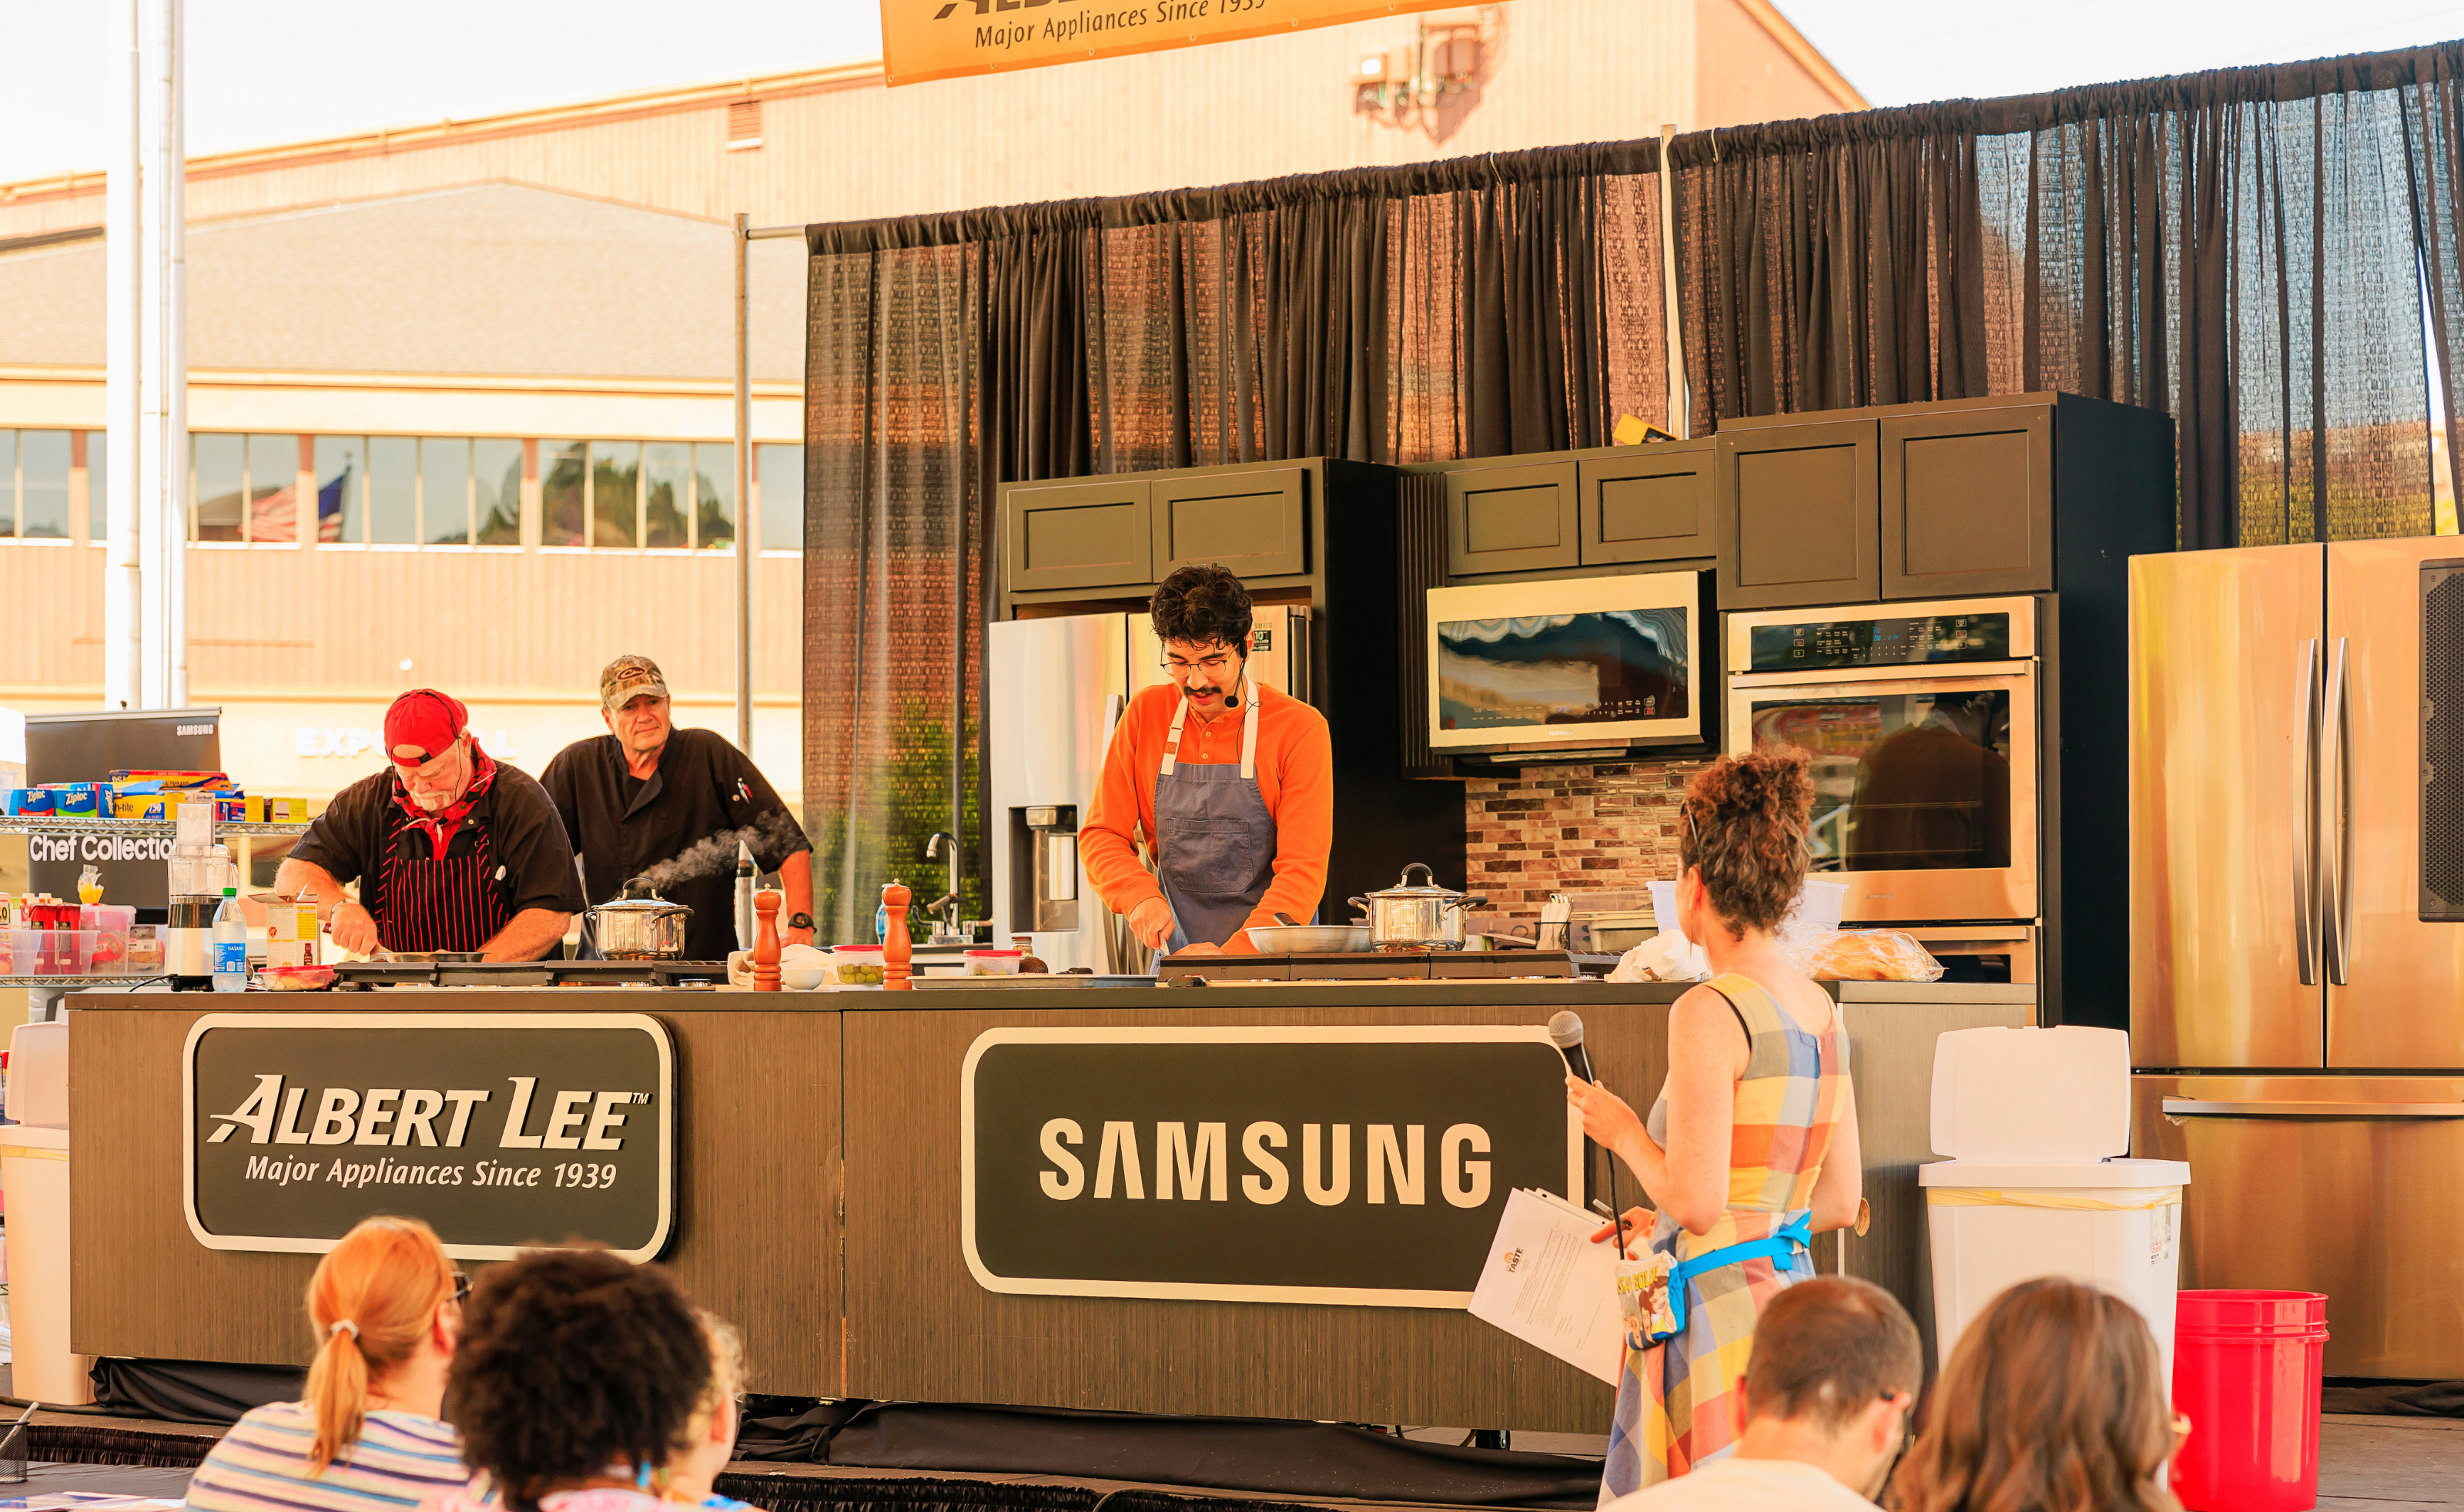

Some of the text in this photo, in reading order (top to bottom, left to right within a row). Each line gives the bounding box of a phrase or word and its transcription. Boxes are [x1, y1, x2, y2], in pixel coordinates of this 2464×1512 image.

[976, 21, 1035, 50] Major
[1043, 9, 1147, 42] Appliances
[1157, 0, 1209, 22] Since
[177, 724, 214, 736] SAMSUNG
[27, 790, 45, 803] Ziploc
[65, 791, 88, 806] Ziploc
[105, 790, 113, 814] Ziploc
[115, 803, 134, 812] h-tite
[149, 803, 162, 813] 750
[29, 832, 176, 862] Chef Collectio
[206, 1074, 491, 1148] ALBERT
[246, 1154, 618, 1190] Major Appliances Since 1939
[1039, 1117, 1492, 1209] SAMSUNG
[1508, 1247, 1523, 1273] TASTE
